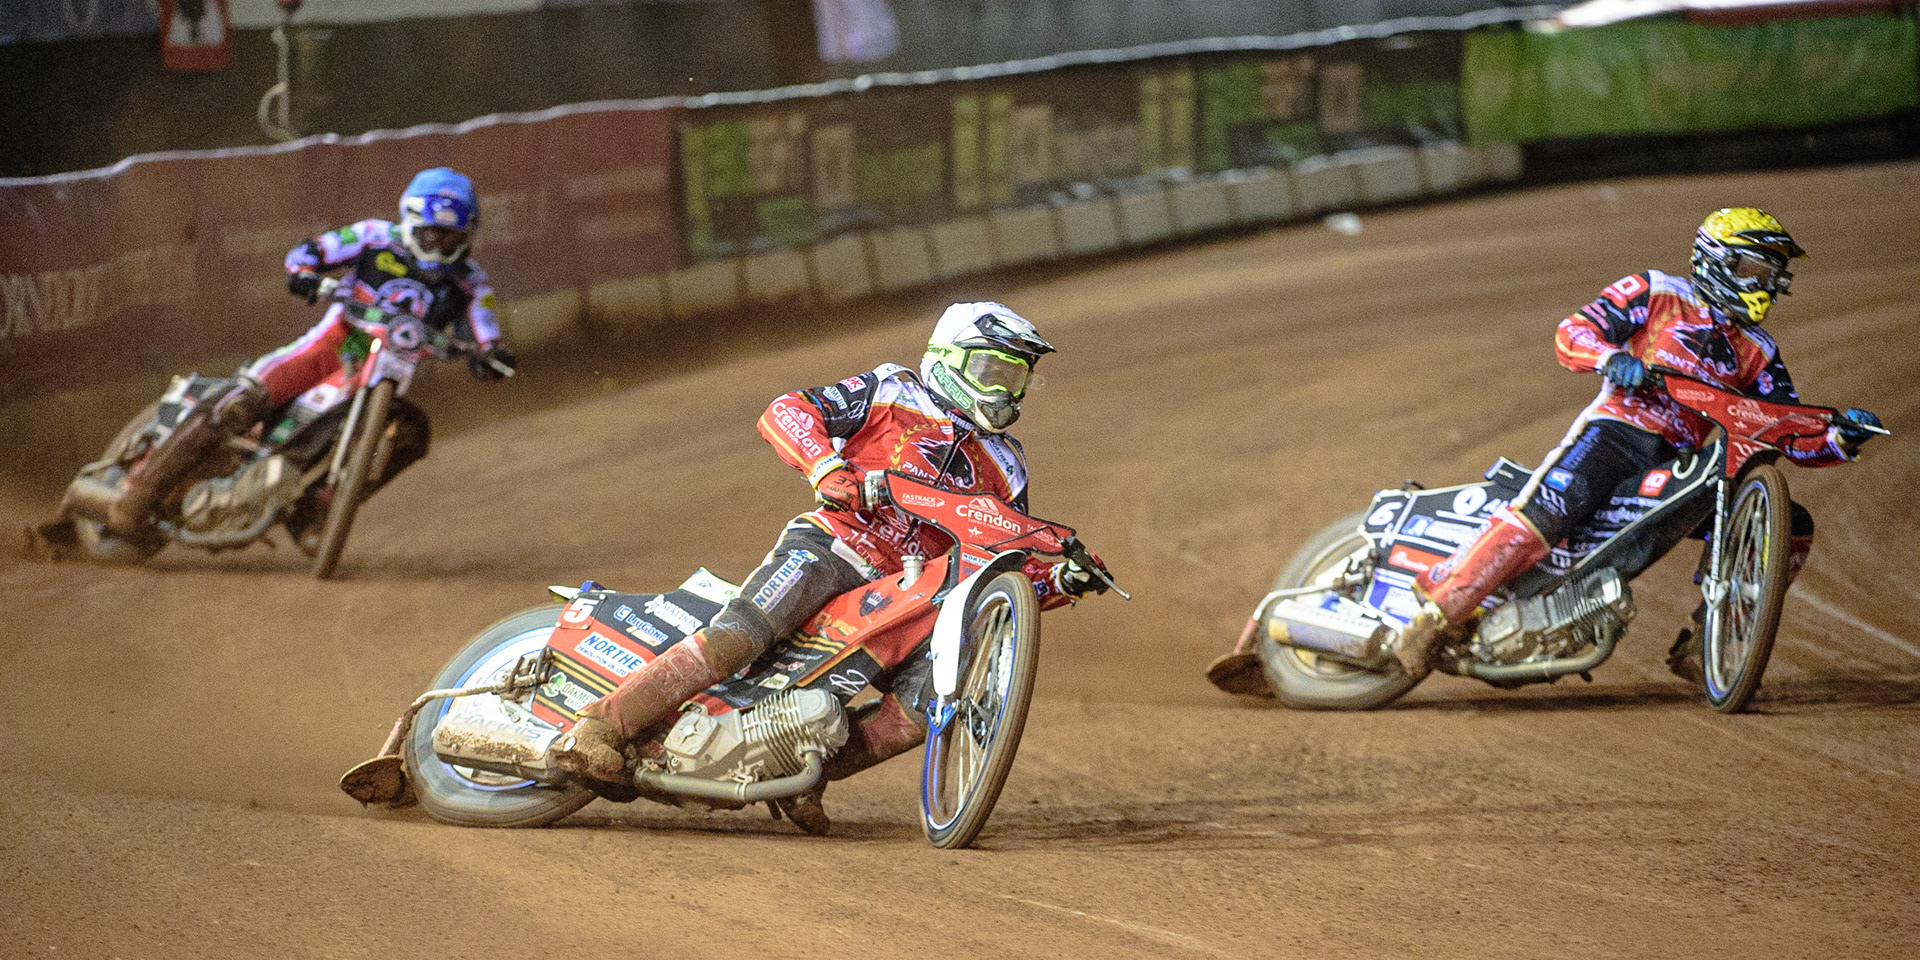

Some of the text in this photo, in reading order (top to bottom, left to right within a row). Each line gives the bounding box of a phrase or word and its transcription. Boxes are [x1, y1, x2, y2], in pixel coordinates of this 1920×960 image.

[771, 402, 822, 457] Crendon
[902, 493, 936, 502] FASTRACK
[955, 505, 1022, 534] Crendon
[1366, 502, 1404, 526] 6
[563, 598, 600, 623] 5
[585, 635, 643, 670] NORTHE
